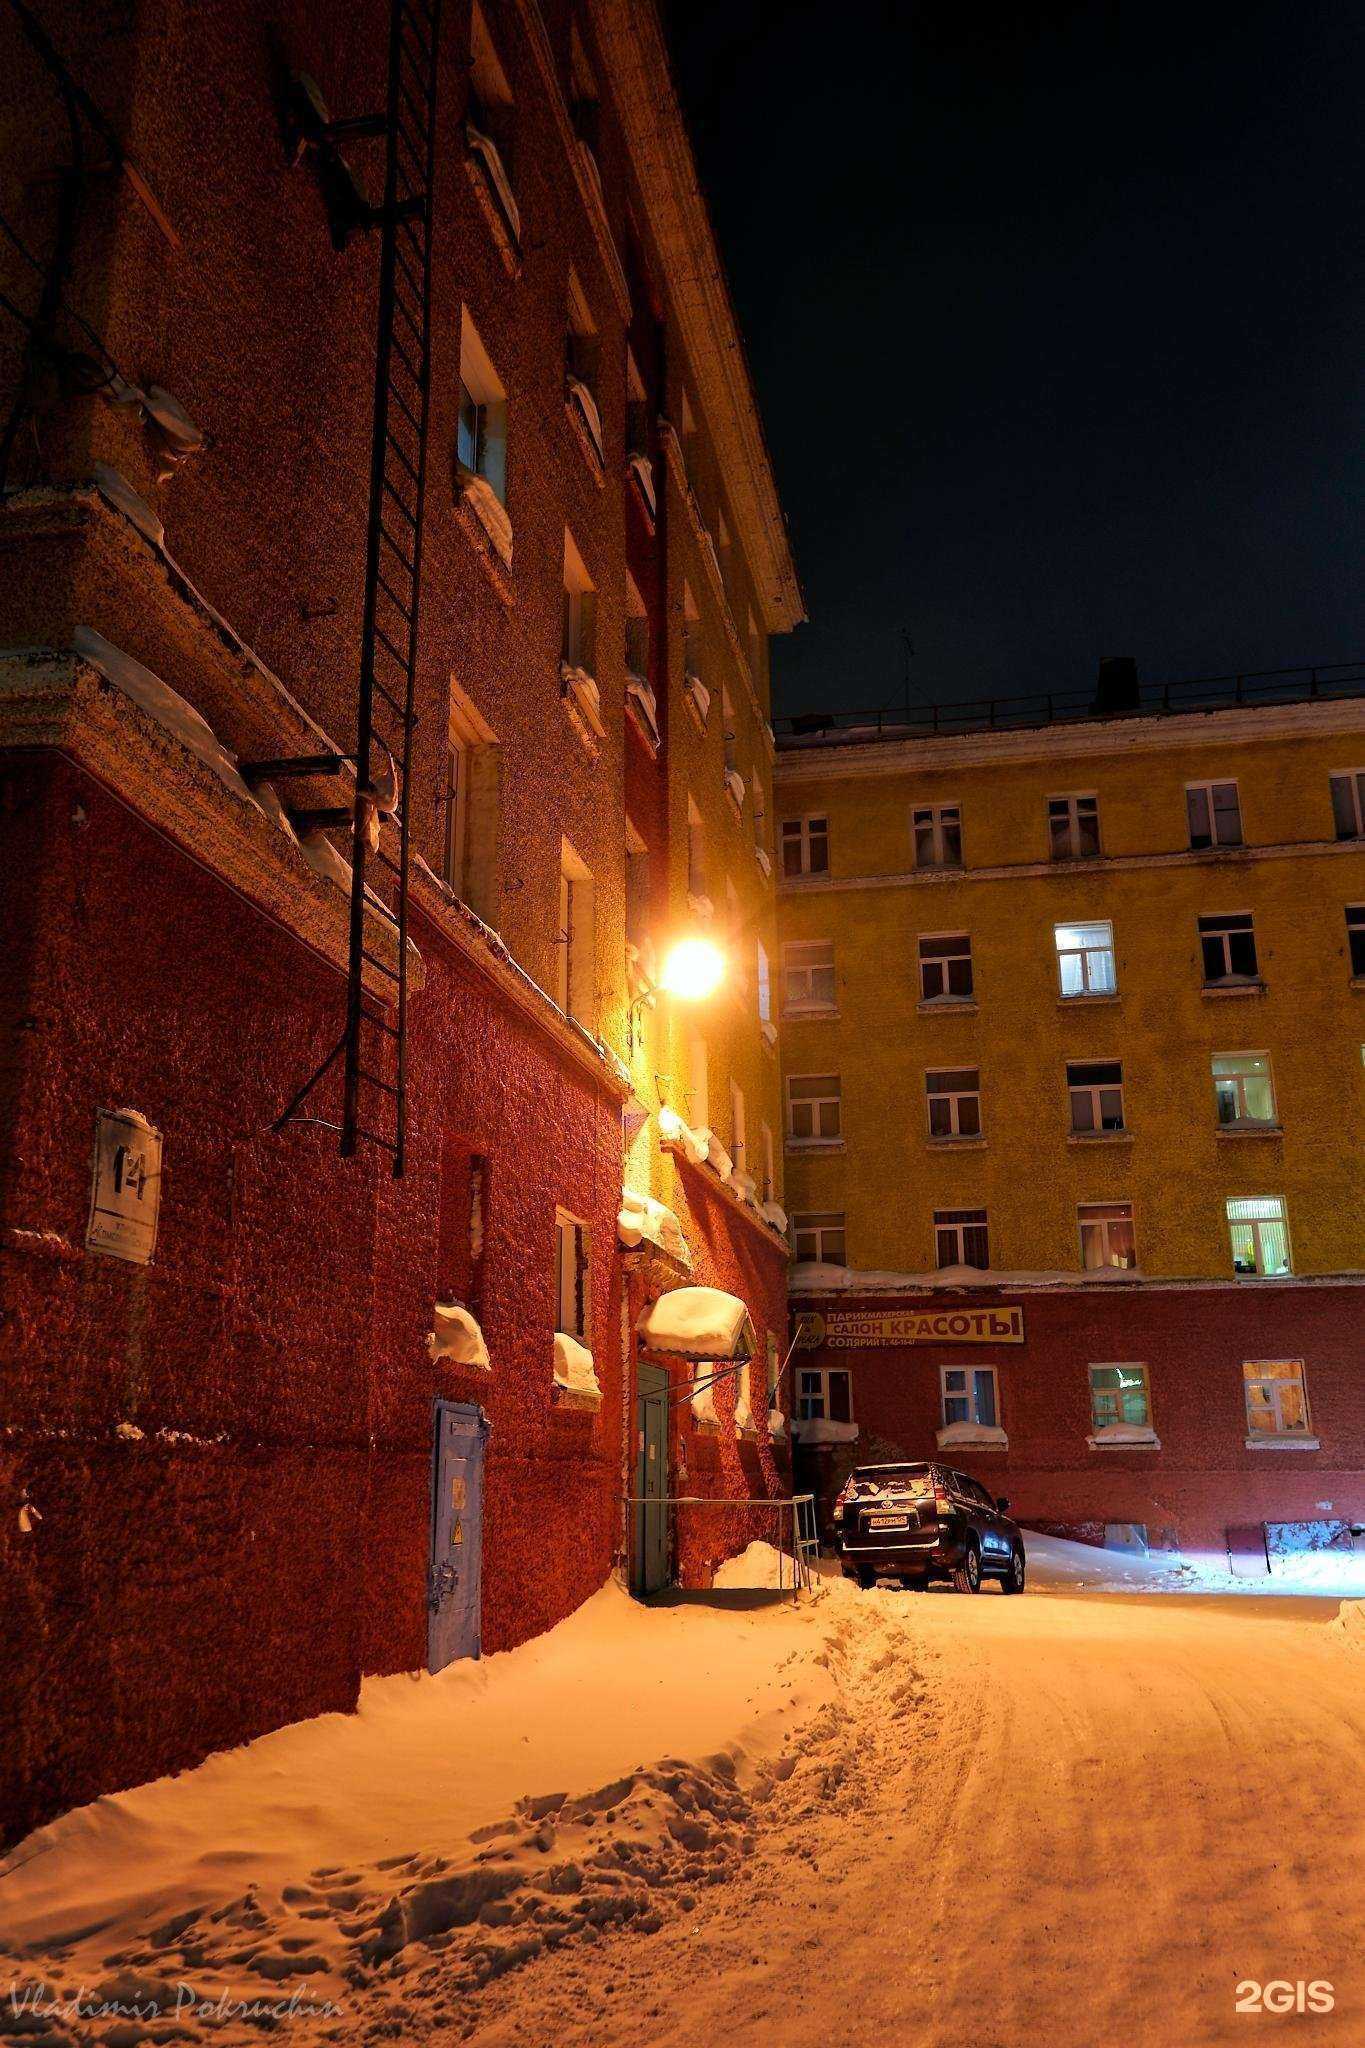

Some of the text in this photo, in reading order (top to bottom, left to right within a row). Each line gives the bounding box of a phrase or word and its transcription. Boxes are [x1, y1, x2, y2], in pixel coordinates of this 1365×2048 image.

[113, 1145, 147, 1200] 14
[834, 1312, 1020, 1336] САЛОН КРАСОТЫ
[827, 1336, 879, 1348] СОЛЯРИЙ
